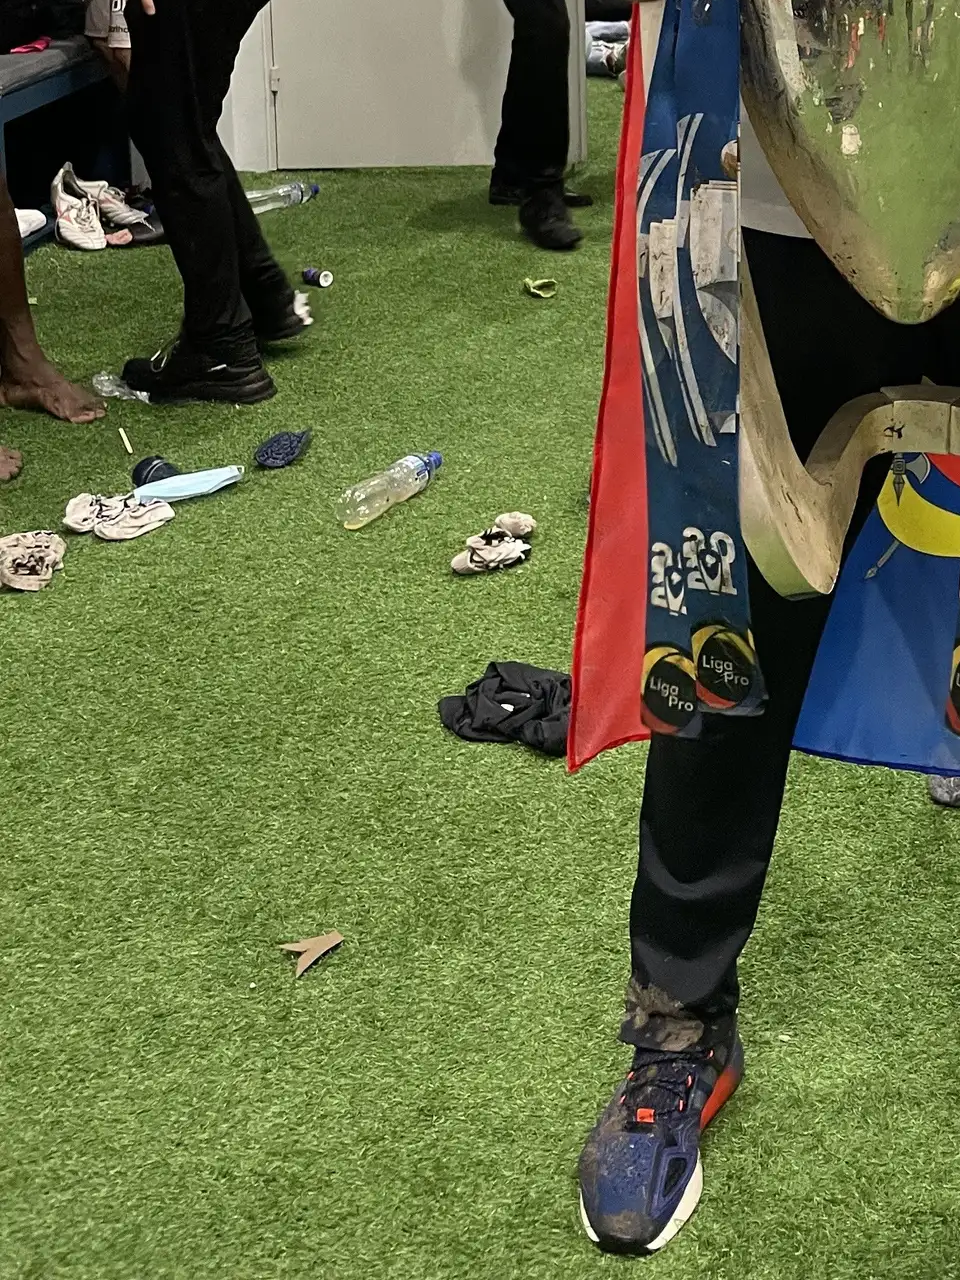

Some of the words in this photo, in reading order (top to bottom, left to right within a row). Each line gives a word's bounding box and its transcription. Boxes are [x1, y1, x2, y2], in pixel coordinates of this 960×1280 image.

[703, 654, 733, 673] Liga
[650, 675, 679, 698] Liga
[724, 671, 750, 686] Pro
[668, 695, 694, 712] Pro
